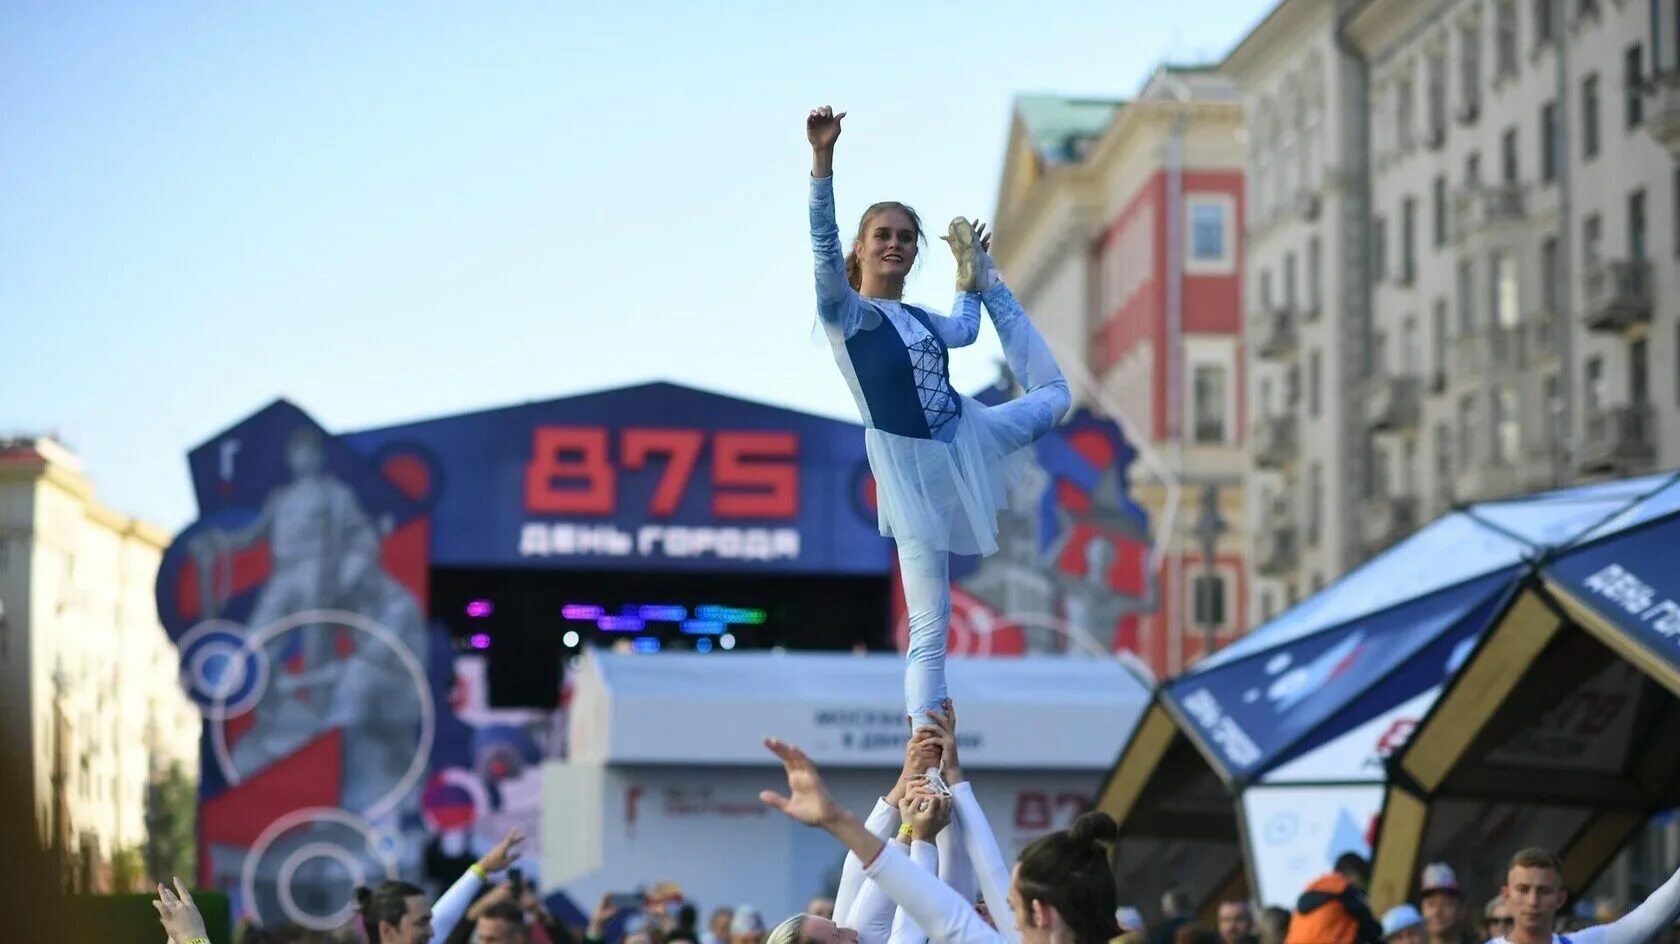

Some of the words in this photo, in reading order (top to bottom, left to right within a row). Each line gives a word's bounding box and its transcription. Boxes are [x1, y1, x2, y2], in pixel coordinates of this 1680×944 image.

[525, 426, 797, 517] 875
[519, 522, 632, 557] ДЕНЬ
[637, 525, 799, 560] ГОРОДА
[1583, 563, 1656, 615] ДЕНЬ
[1641, 599, 1680, 645] ГО
